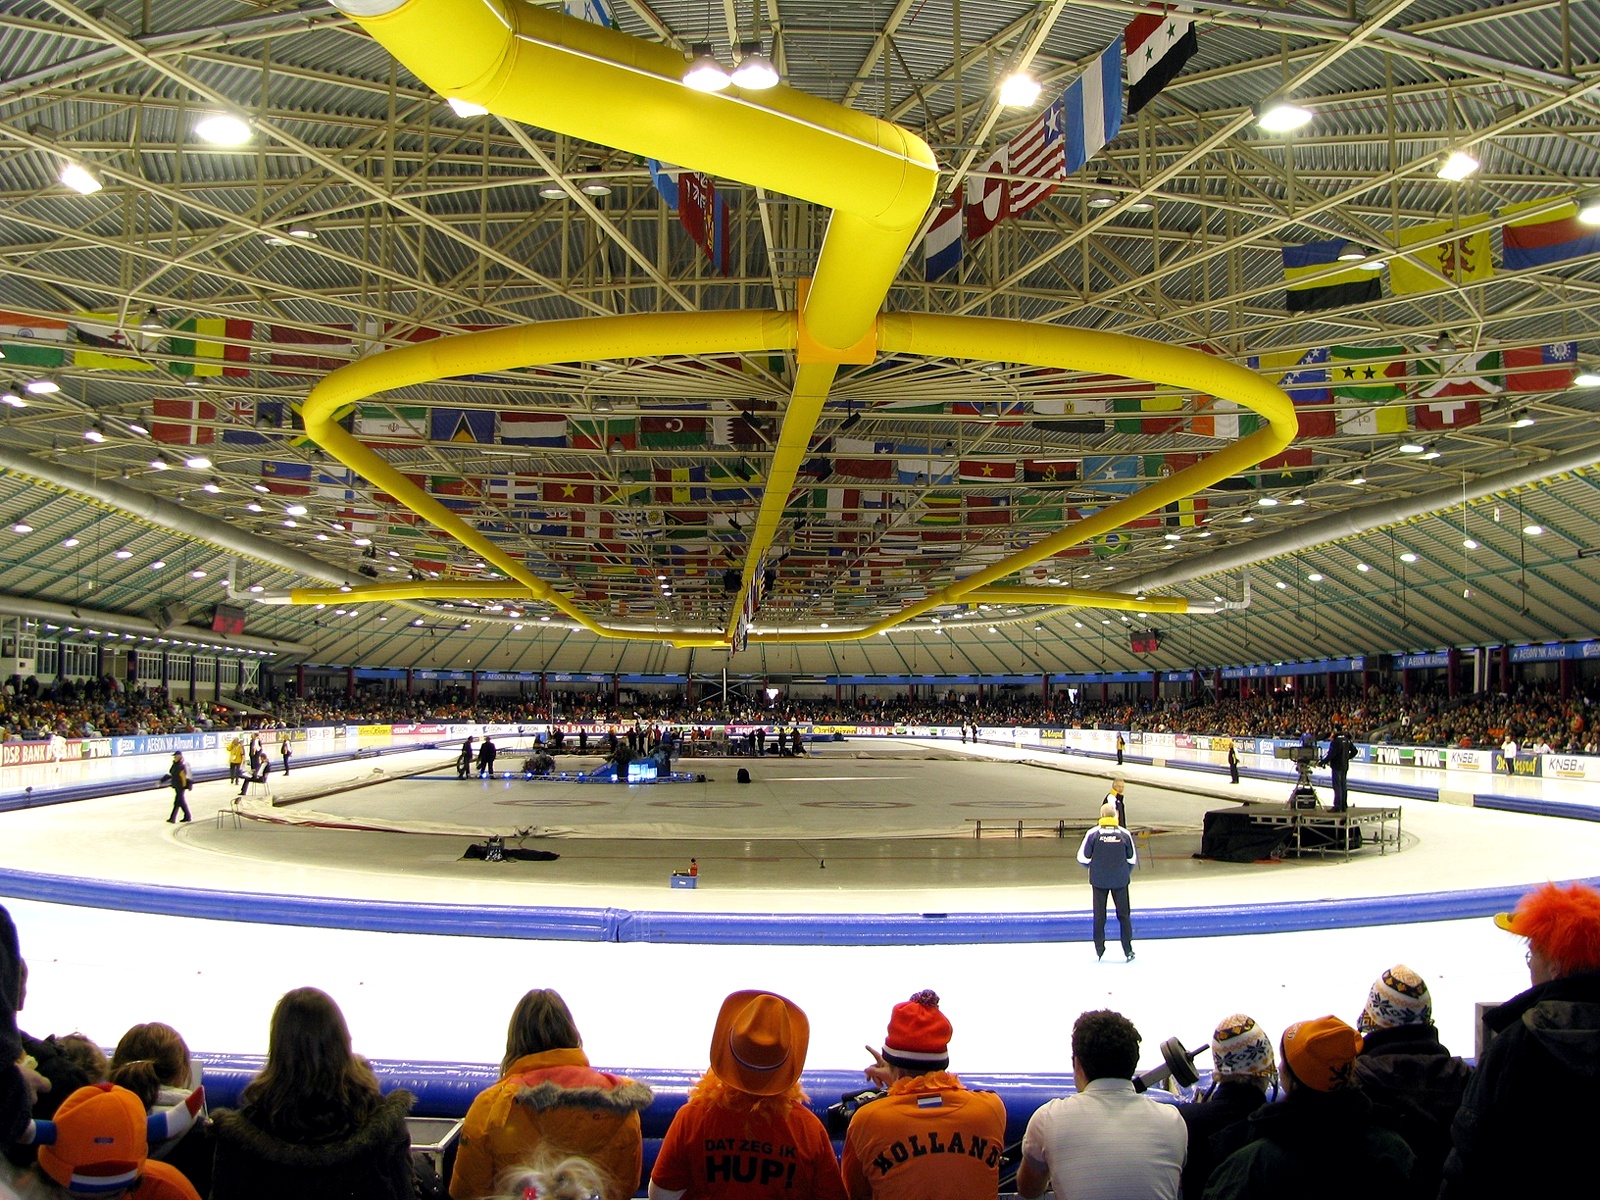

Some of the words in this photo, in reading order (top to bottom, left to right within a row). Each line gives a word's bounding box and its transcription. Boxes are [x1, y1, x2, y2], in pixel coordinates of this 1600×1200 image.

[857, 727, 872, 735] DSB
[89, 740, 112, 757] TVM
[147, 737, 166, 752] AEGON
[174, 736, 194, 750] Allround
[3, 745, 21, 764] DSB
[22, 744, 46, 762] BANK
[1377, 747, 1400, 764] TVM
[1413, 748, 1440, 767] TVM
[705, 1139, 735, 1152] DAT
[740, 1140, 773, 1154] ZEG
[779, 1145, 797, 1160] IK
[873, 1132, 1000, 1175] HOLLAND
[705, 1155, 797, 1189] HUP!
